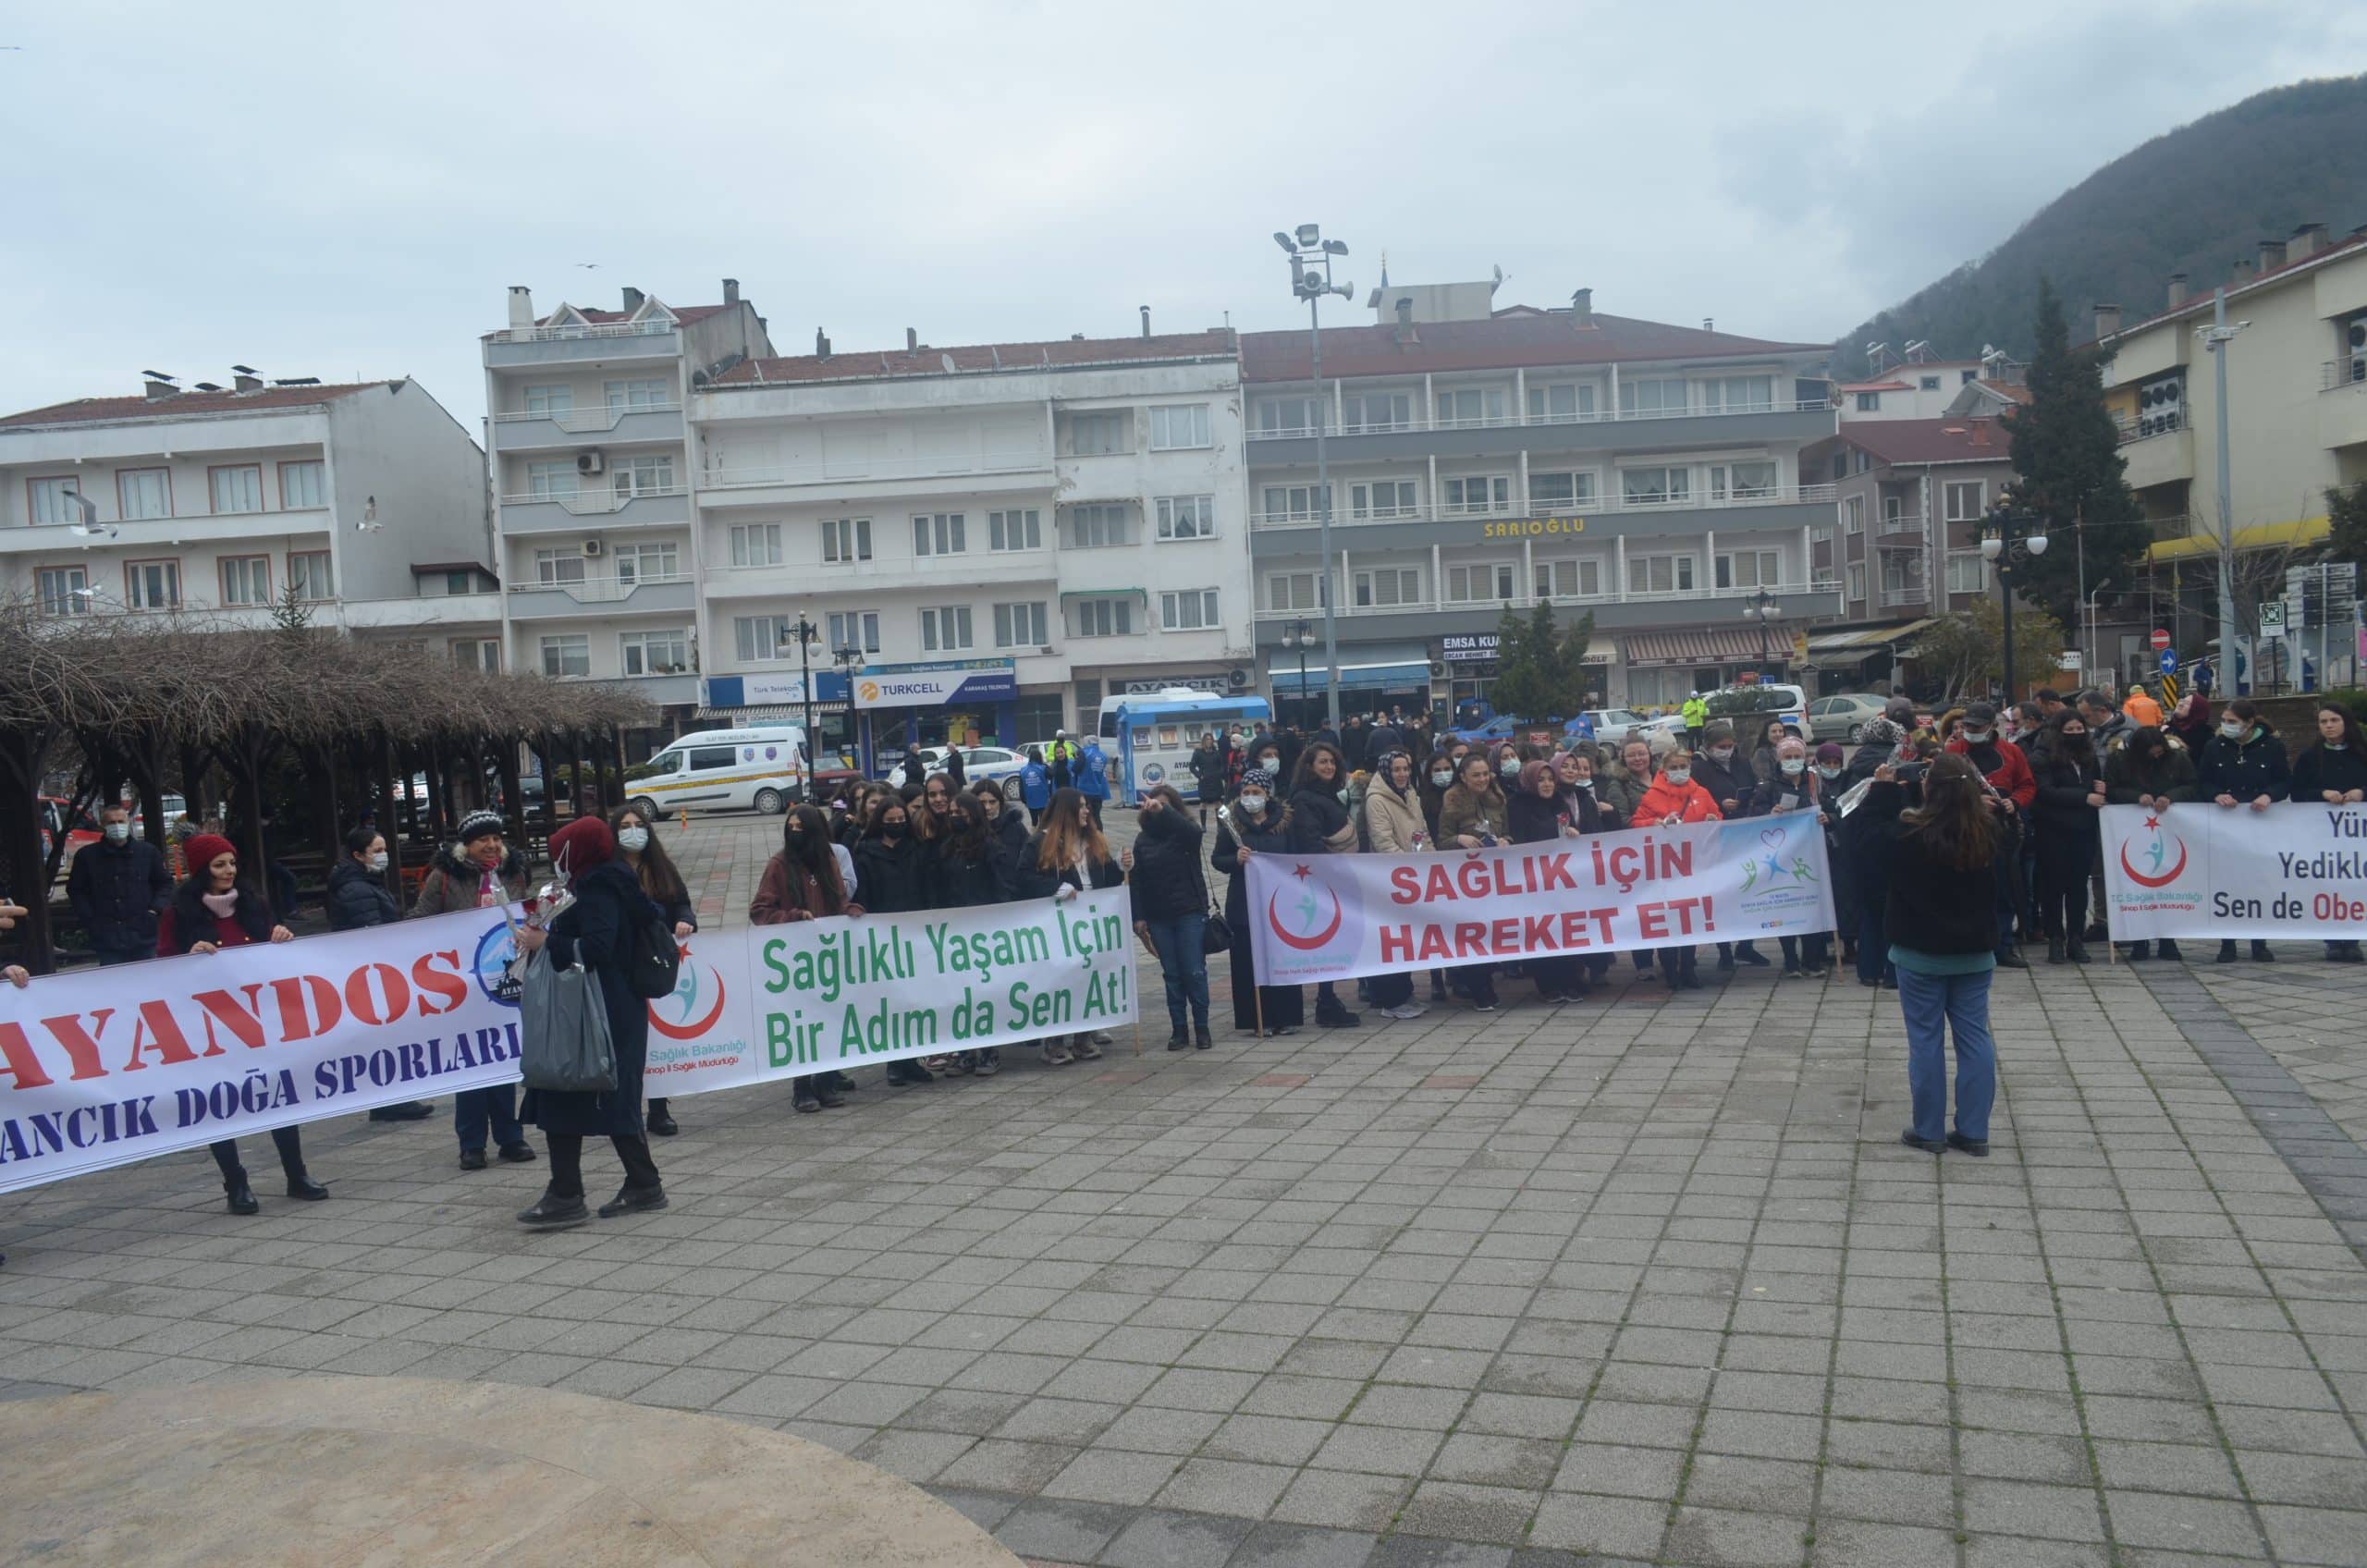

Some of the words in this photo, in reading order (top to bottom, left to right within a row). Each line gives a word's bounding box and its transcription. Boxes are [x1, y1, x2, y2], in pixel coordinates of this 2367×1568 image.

[1484, 518, 1584, 537] SARIOĞLU
[1443, 638, 1477, 649] EMSA
[1479, 636, 1502, 646] KUA
[770, 685, 800, 693] Telekom
[881, 682, 944, 696] TURKCELL
[1129, 680, 1227, 692] AYANCIK
[1390, 852, 1577, 907] SAĞLIK
[1591, 835, 1694, 894] İÇİN
[2214, 892, 2262, 919] Sen
[2272, 891, 2303, 919] de
[1379, 909, 1620, 963] HAREKET
[1637, 895, 1716, 941] ET!
[763, 925, 915, 1003] Sağlıklı
[926, 920, 1049, 983] Yaşam
[1056, 900, 1123, 971] İçin
[766, 1006, 824, 1069] Bir
[839, 996, 938, 1059] Adım
[950, 986, 995, 1042] da
[1007, 980, 1072, 1033] Sen
[1084, 964, 1128, 1019] At!
[650, 1047, 689, 1063] Sağlık
[692, 1038, 747, 1055] Bakanlığı
[0, 1095, 159, 1165] ANCIK
[176, 1068, 300, 1128] DOĞA
[314, 1023, 521, 1100] SPORLARI
